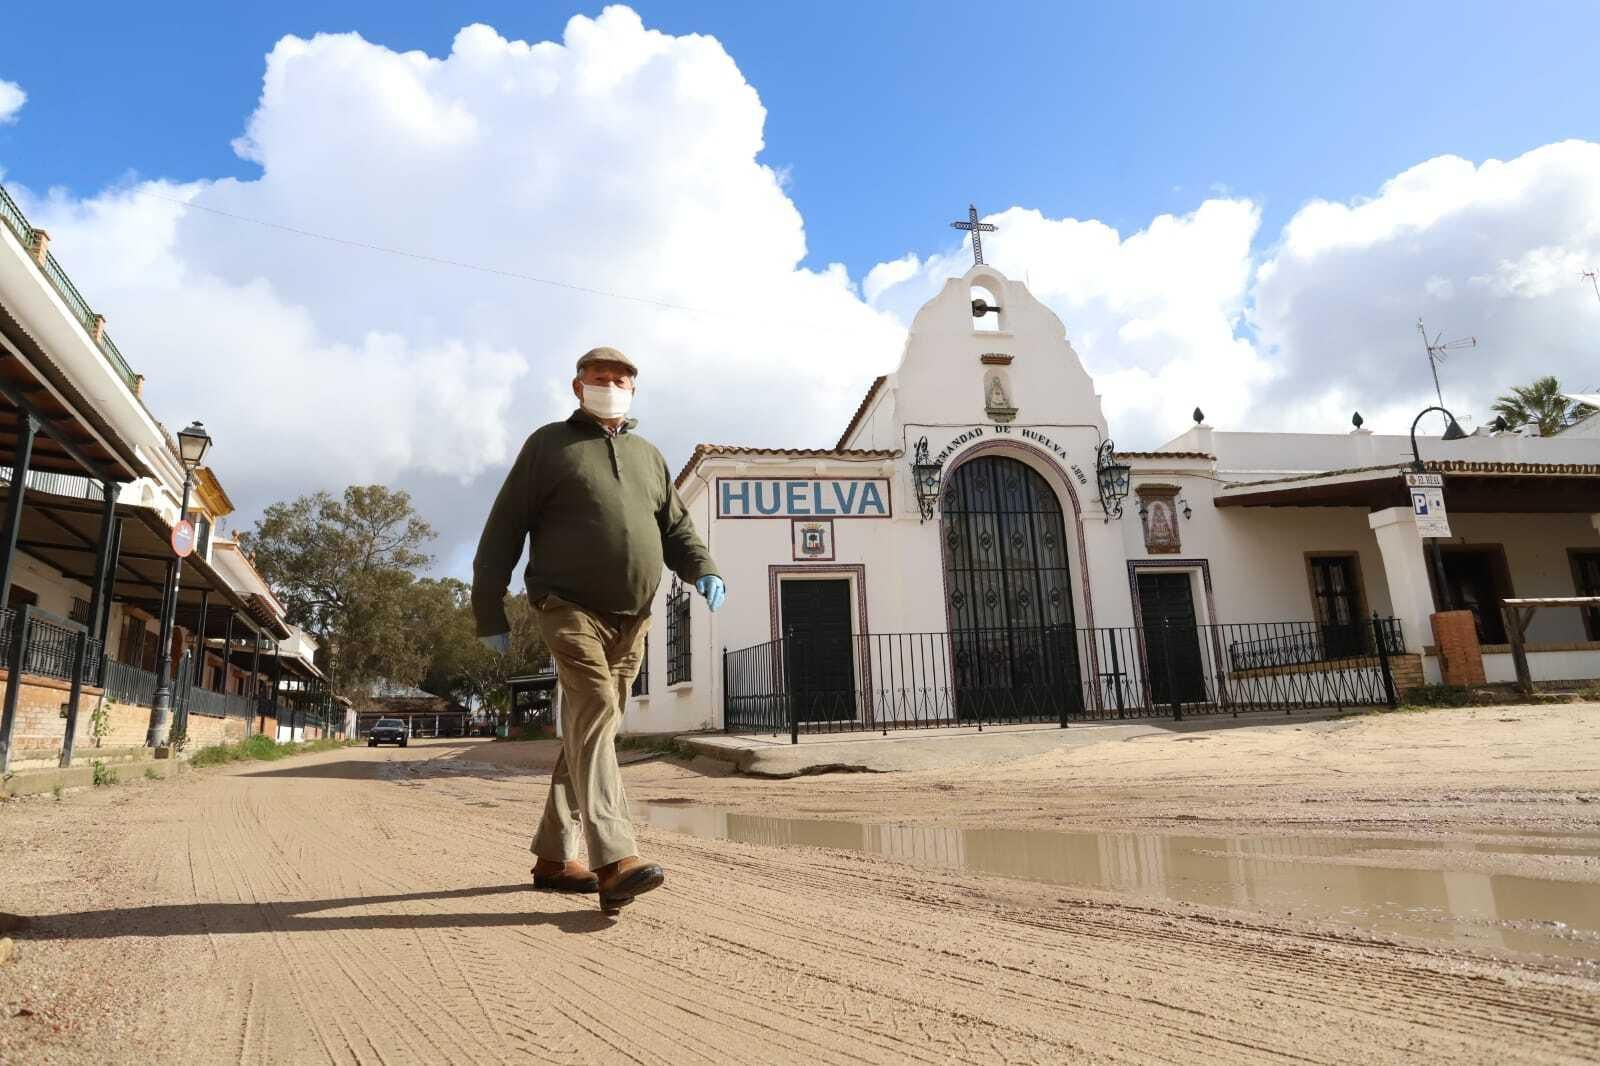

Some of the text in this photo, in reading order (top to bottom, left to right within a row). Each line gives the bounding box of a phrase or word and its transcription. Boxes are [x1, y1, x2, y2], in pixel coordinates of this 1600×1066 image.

[995, 425, 1011, 434] DE
[1022, 428, 1068, 460] HUELVA
[722, 481, 886, 515] HUELVA
